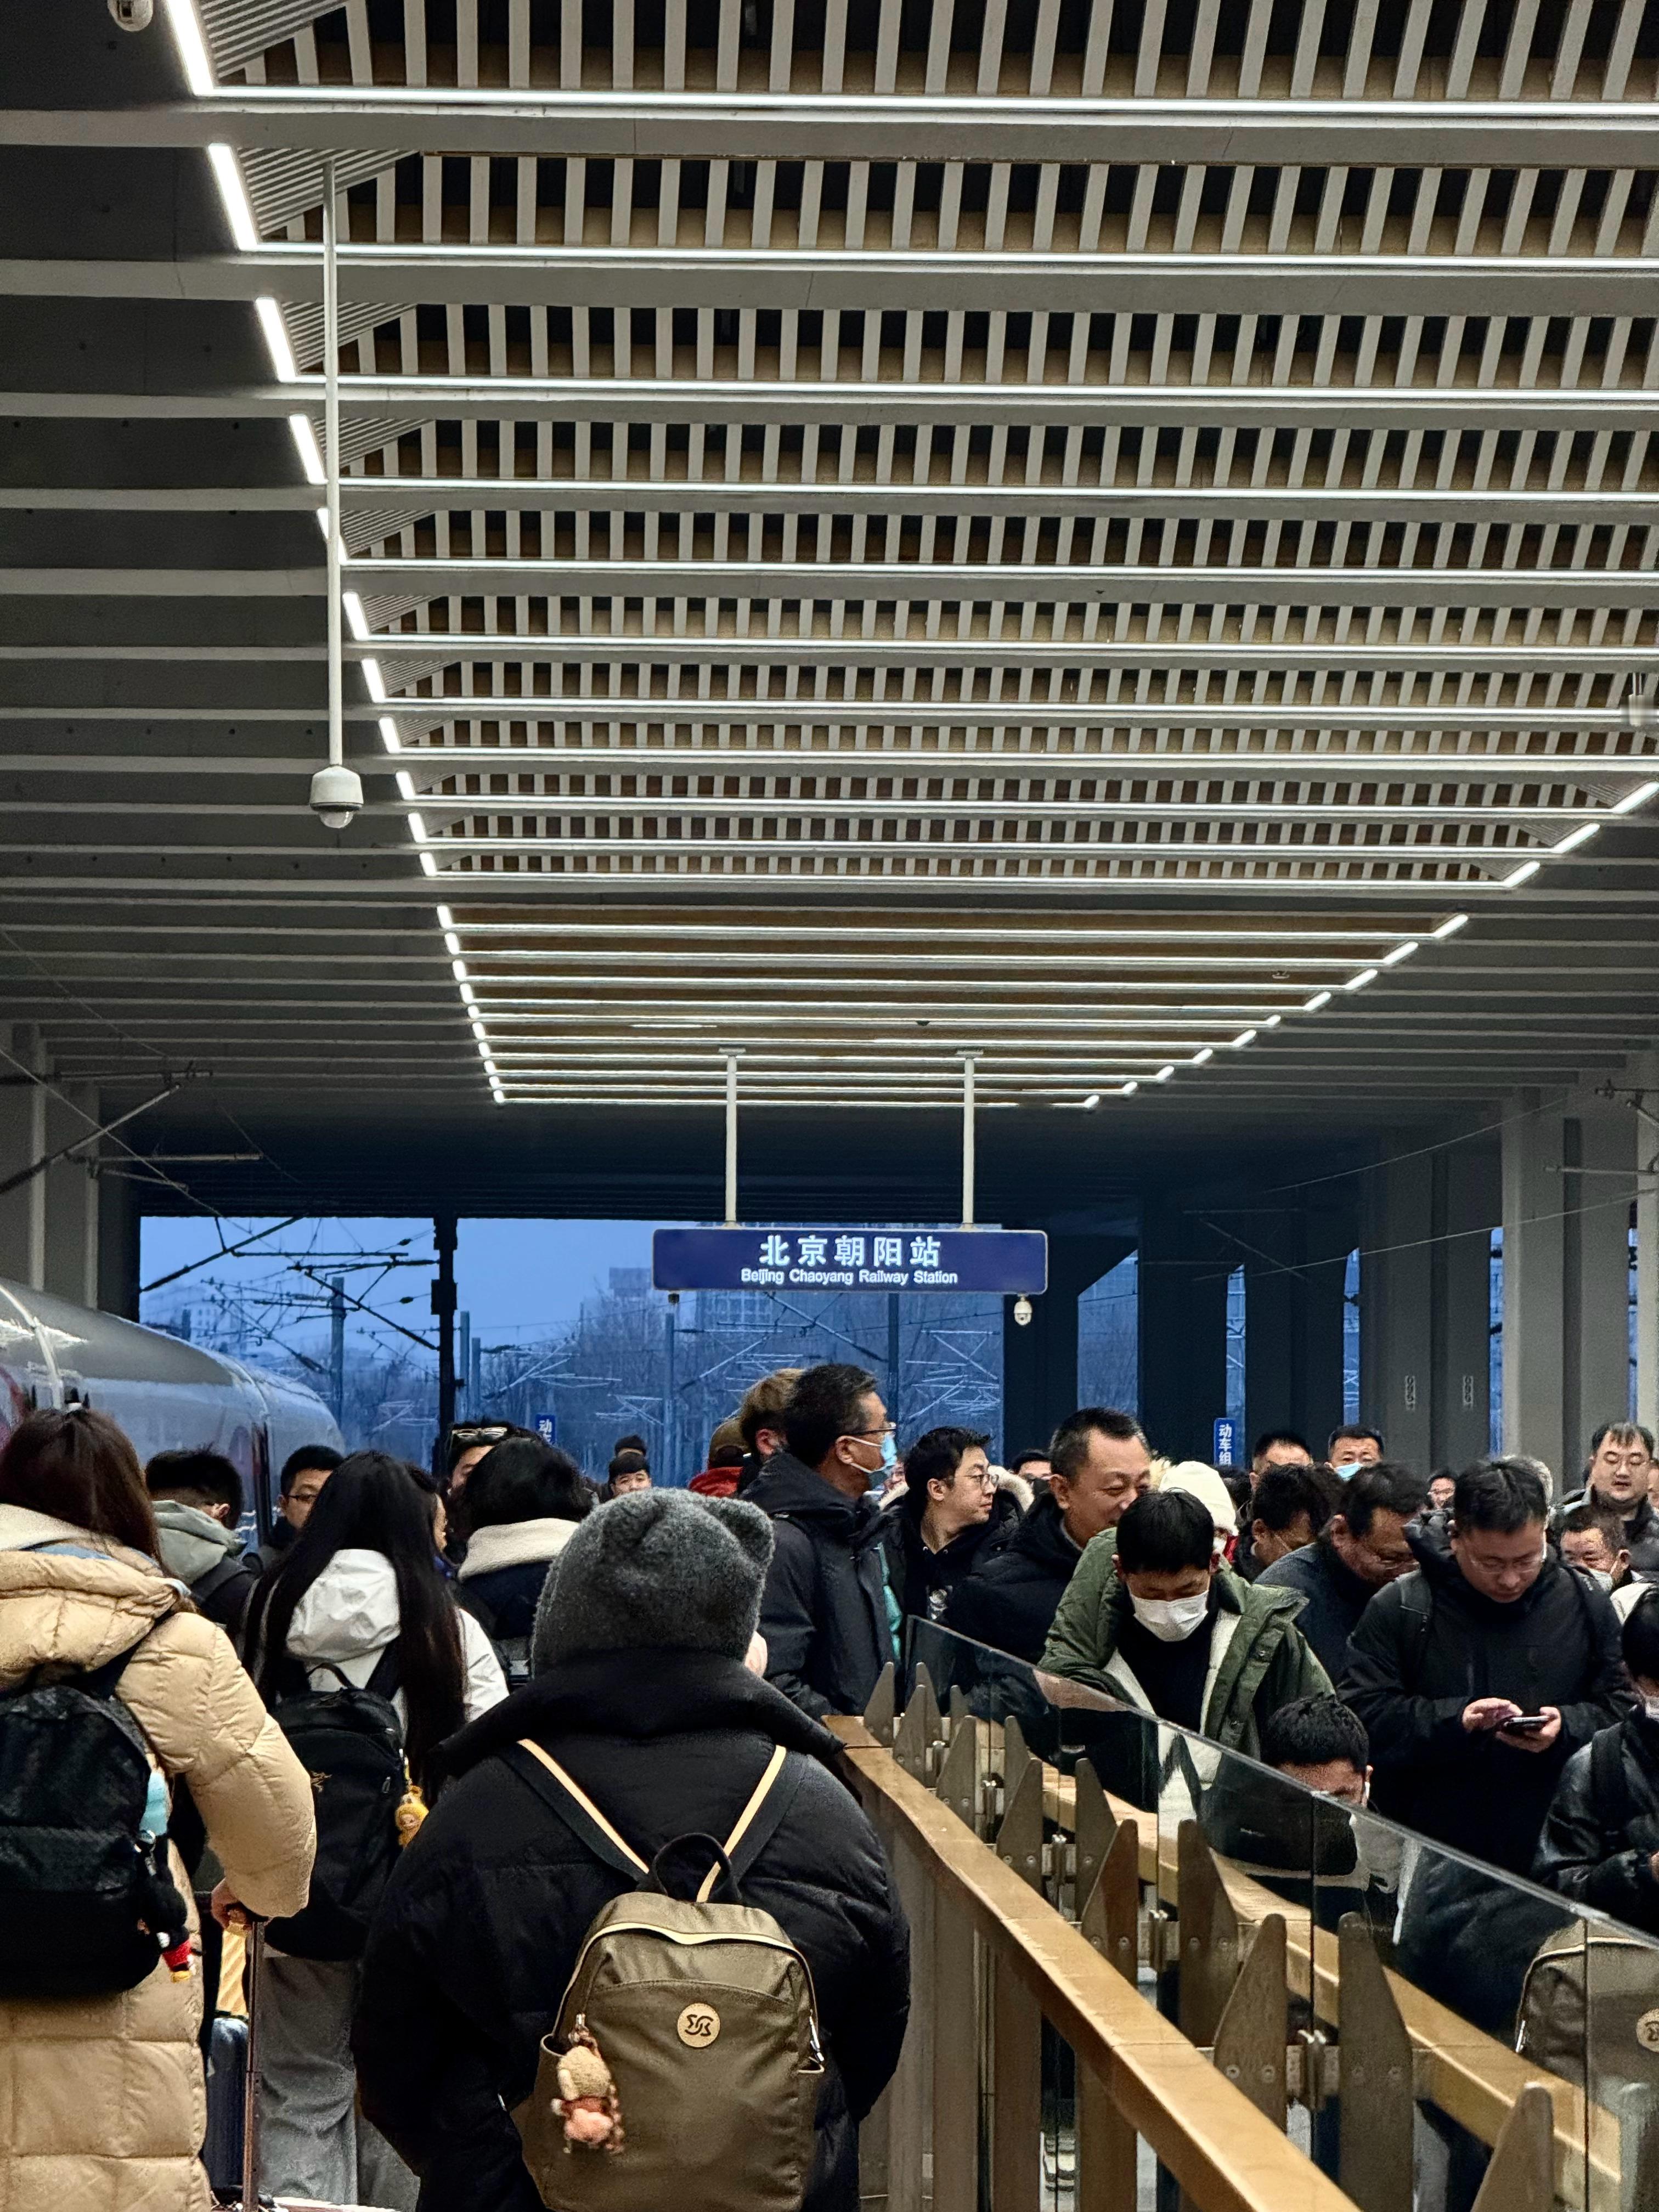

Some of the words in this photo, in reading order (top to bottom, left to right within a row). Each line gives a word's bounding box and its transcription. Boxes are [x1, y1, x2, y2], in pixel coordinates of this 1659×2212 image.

[759, 1235, 941, 1267] 北京朝阳站
[741, 1268, 785, 1285] Beijing
[789, 1268, 854, 1285] Chaoyang
[859, 1269, 909, 1286] Railway
[913, 1270, 958, 1284] Station
[1218, 1423, 1232, 1465] 动车组
